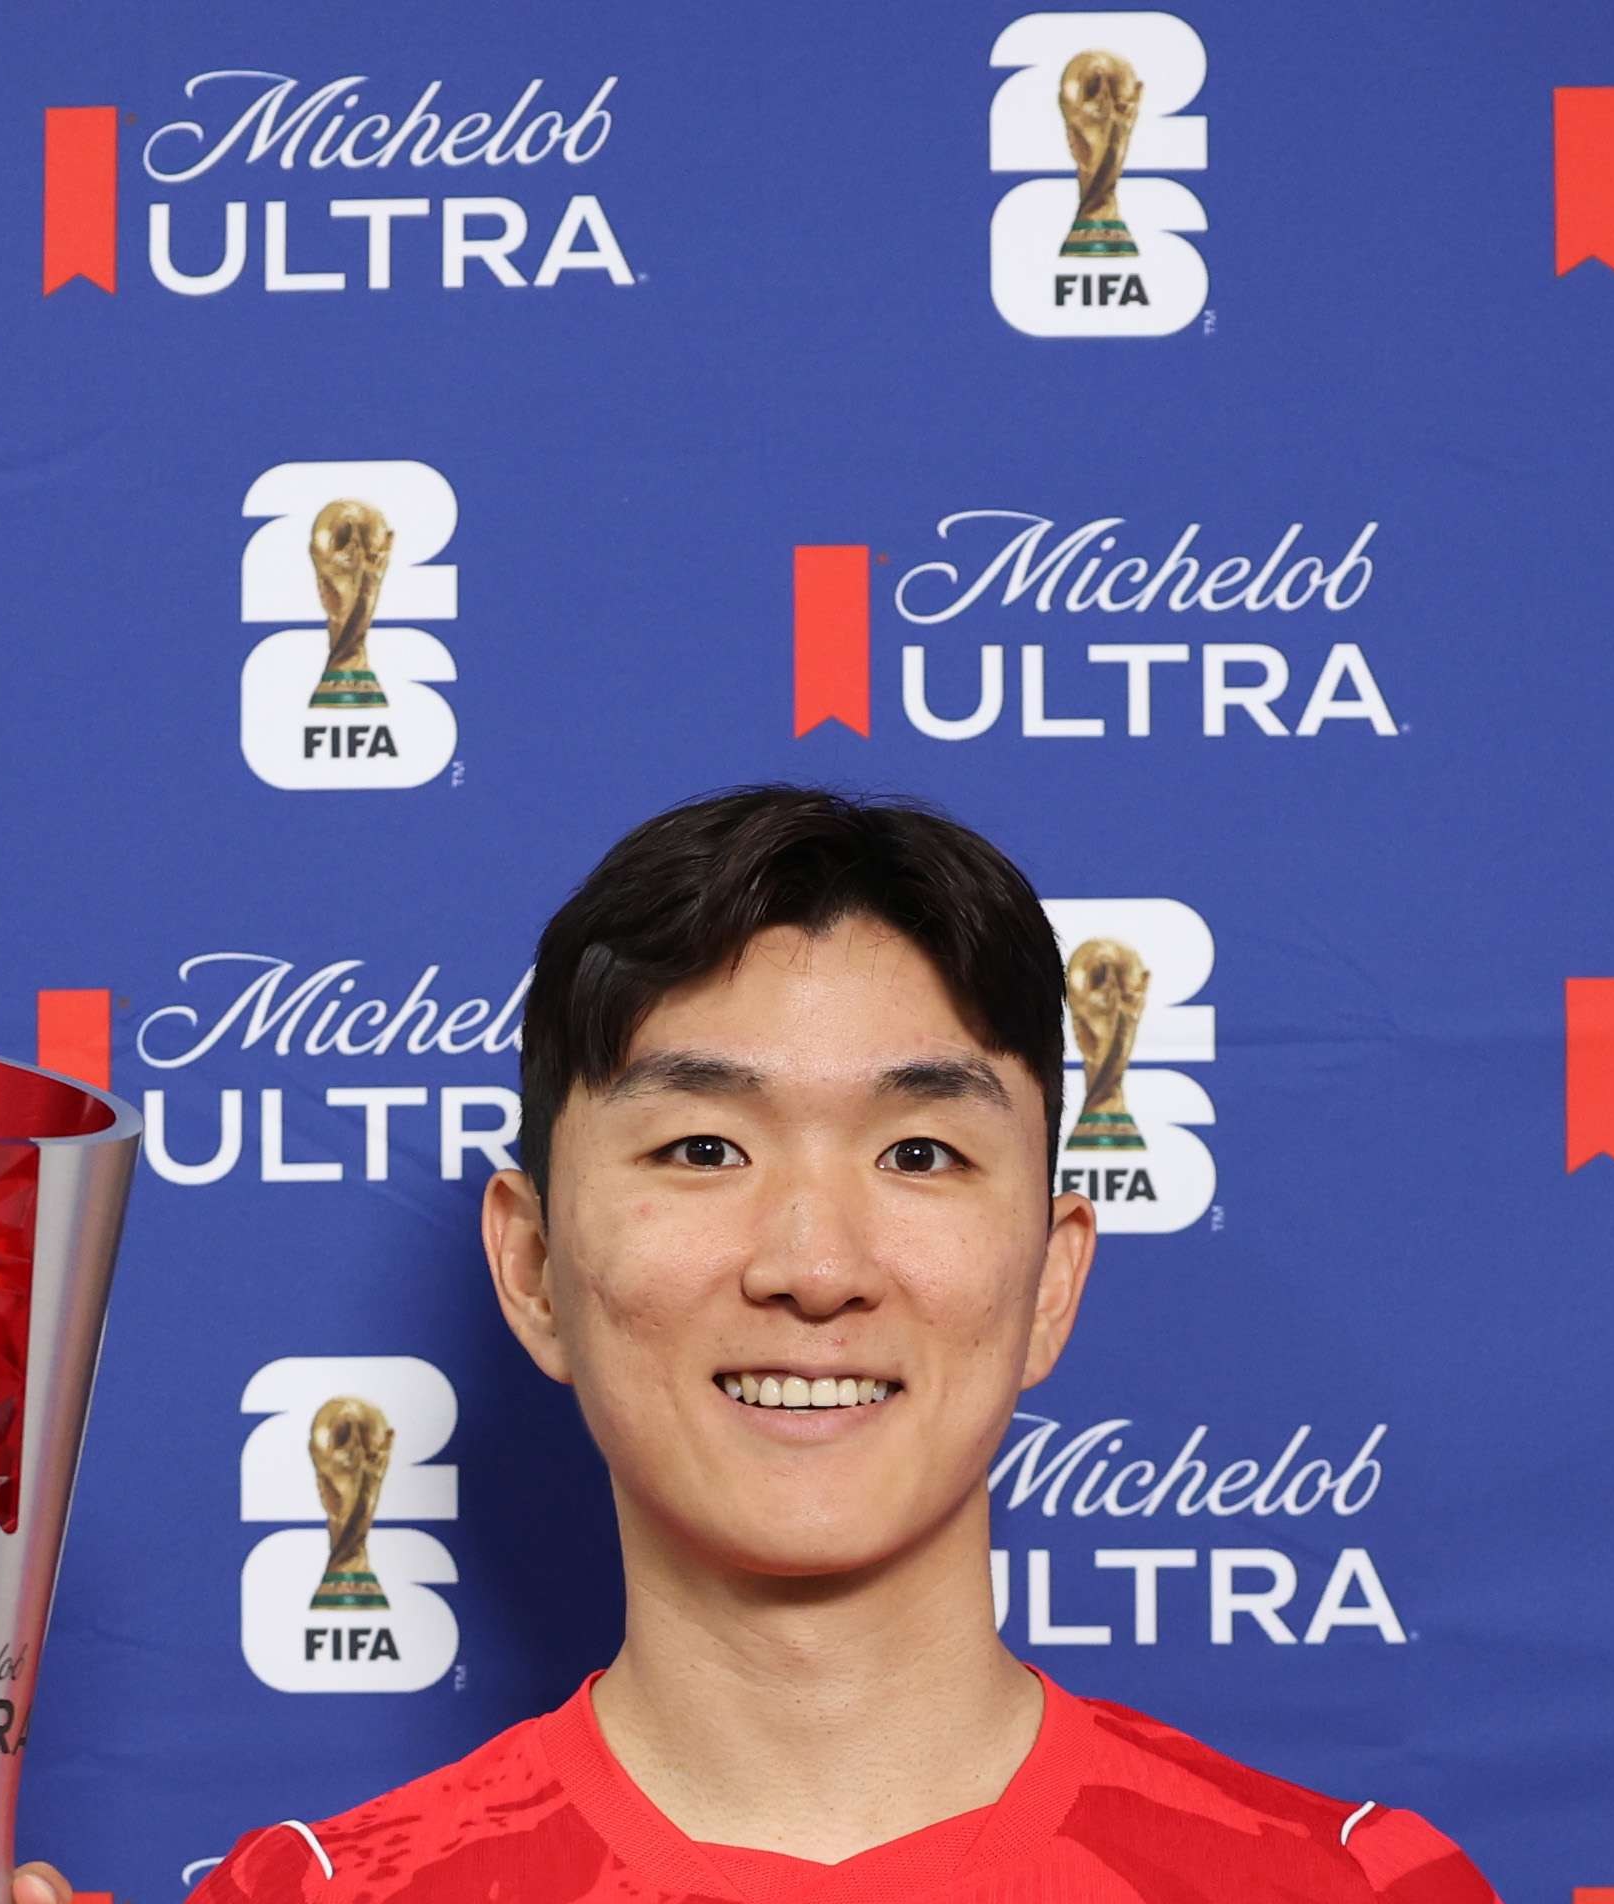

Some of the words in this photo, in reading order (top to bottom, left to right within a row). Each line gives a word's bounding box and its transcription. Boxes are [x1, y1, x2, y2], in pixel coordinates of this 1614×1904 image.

[143, 70, 618, 184] Michelob
[149, 195, 635, 296] ULTRA
[1055, 274, 1149, 306] FIFA
[895, 510, 1378, 624] Michelob
[902, 643, 1399, 741] ULTRA
[304, 725, 398, 759] FIFA
[137, 952, 536, 1069] Michel
[143, 1086, 524, 1185] ULTR
[1060, 1168, 1158, 1202] FIFA
[988, 1412, 1388, 1517] Michelob
[305, 1628, 400, 1661] FIFA
